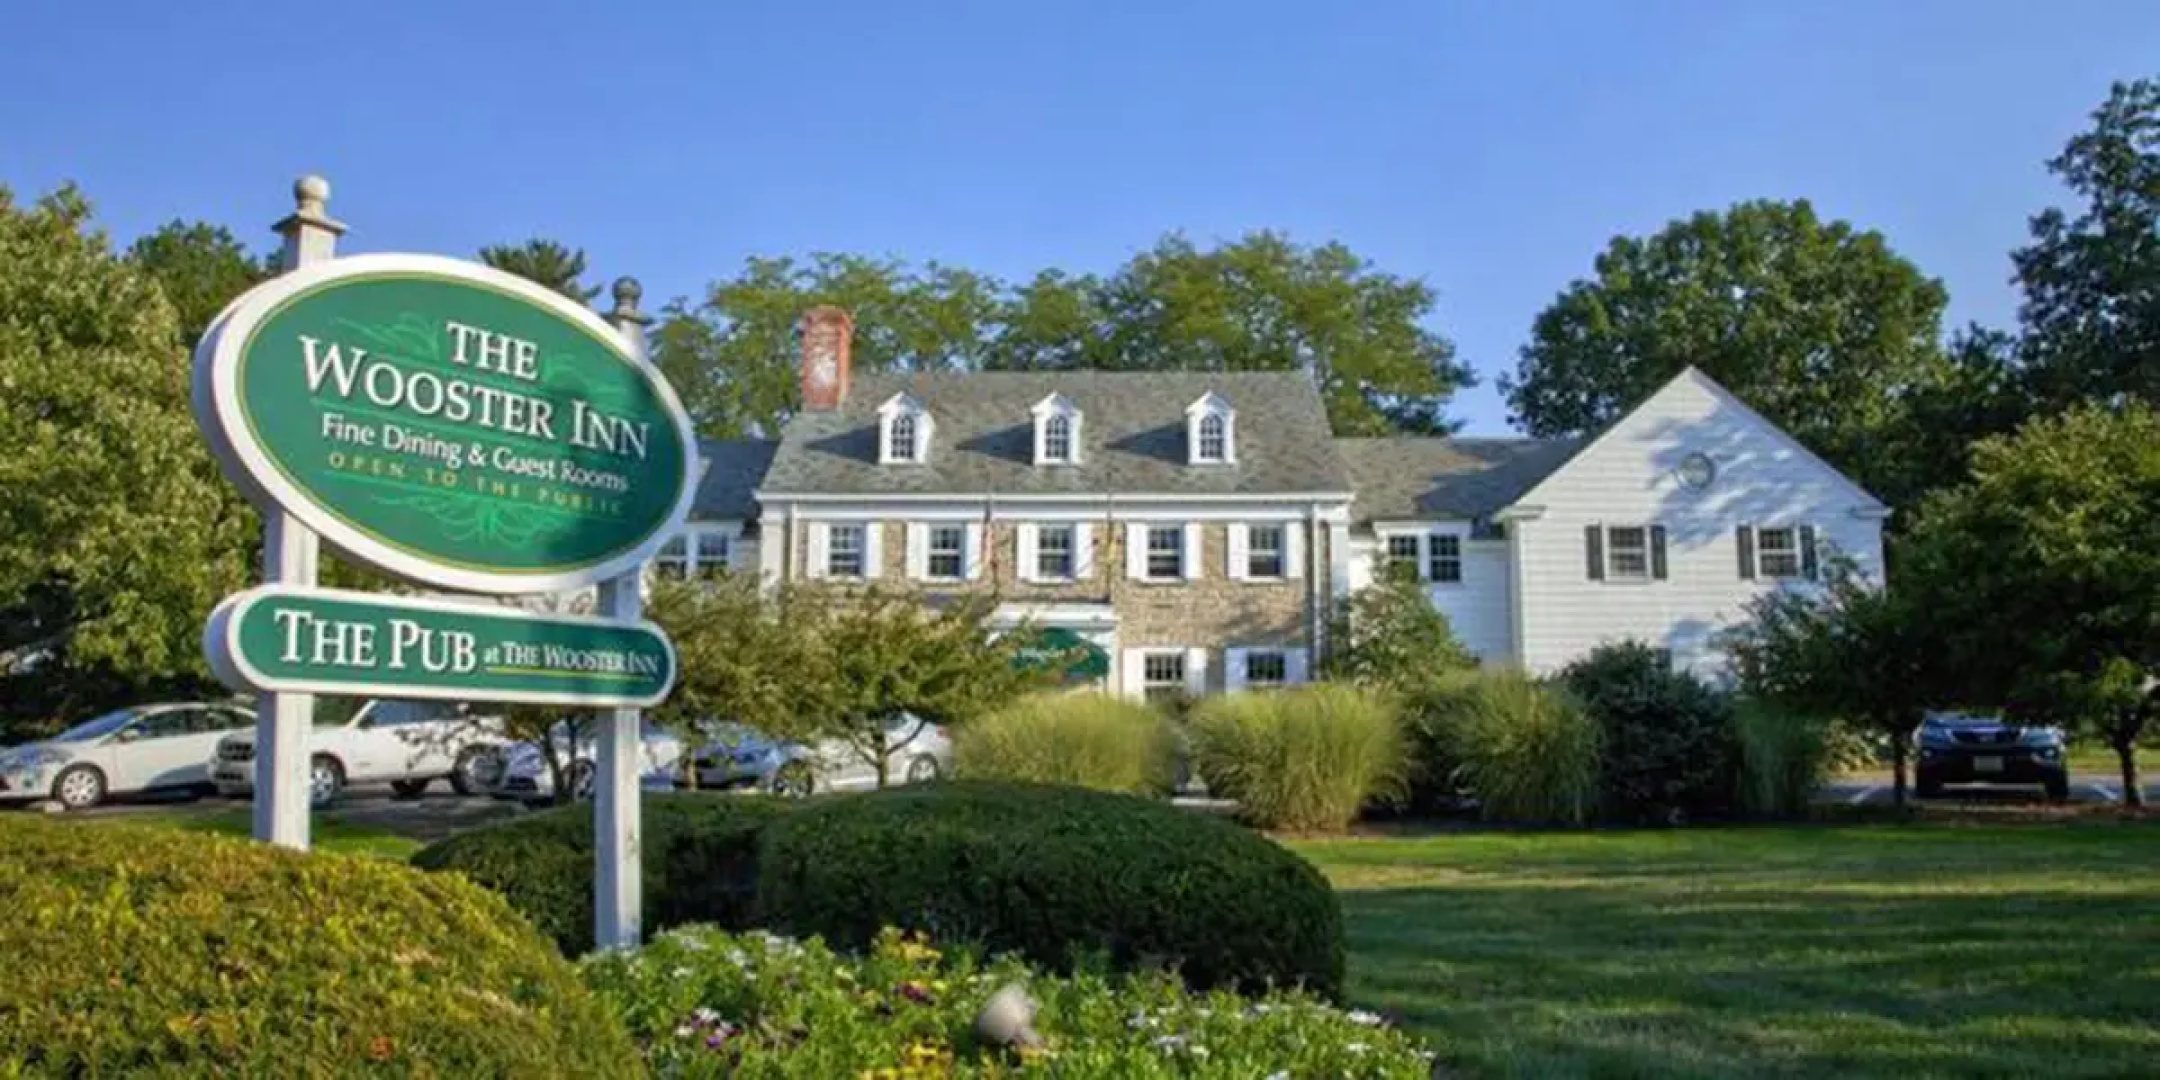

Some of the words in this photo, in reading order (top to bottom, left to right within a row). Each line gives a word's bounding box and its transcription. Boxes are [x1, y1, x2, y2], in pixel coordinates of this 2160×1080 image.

[447, 321, 538, 380] THE
[298, 334, 555, 440] WOOSTER
[570, 398, 649, 459] INN
[323, 412, 376, 446] Fine
[382, 424, 462, 469] Dining
[467, 442, 486, 466] &
[492, 446, 556, 481] Guest
[561, 459, 628, 492] Rooms
[329, 451, 404, 478] OPEN
[425, 467, 457, 487] TO
[274, 609, 376, 667] THE
[388, 619, 477, 673] PUB
[483, 644, 500, 664] at
[502, 640, 540, 665] THE
[542, 643, 626, 672] WOOSTER
[627, 651, 659, 674] INN
